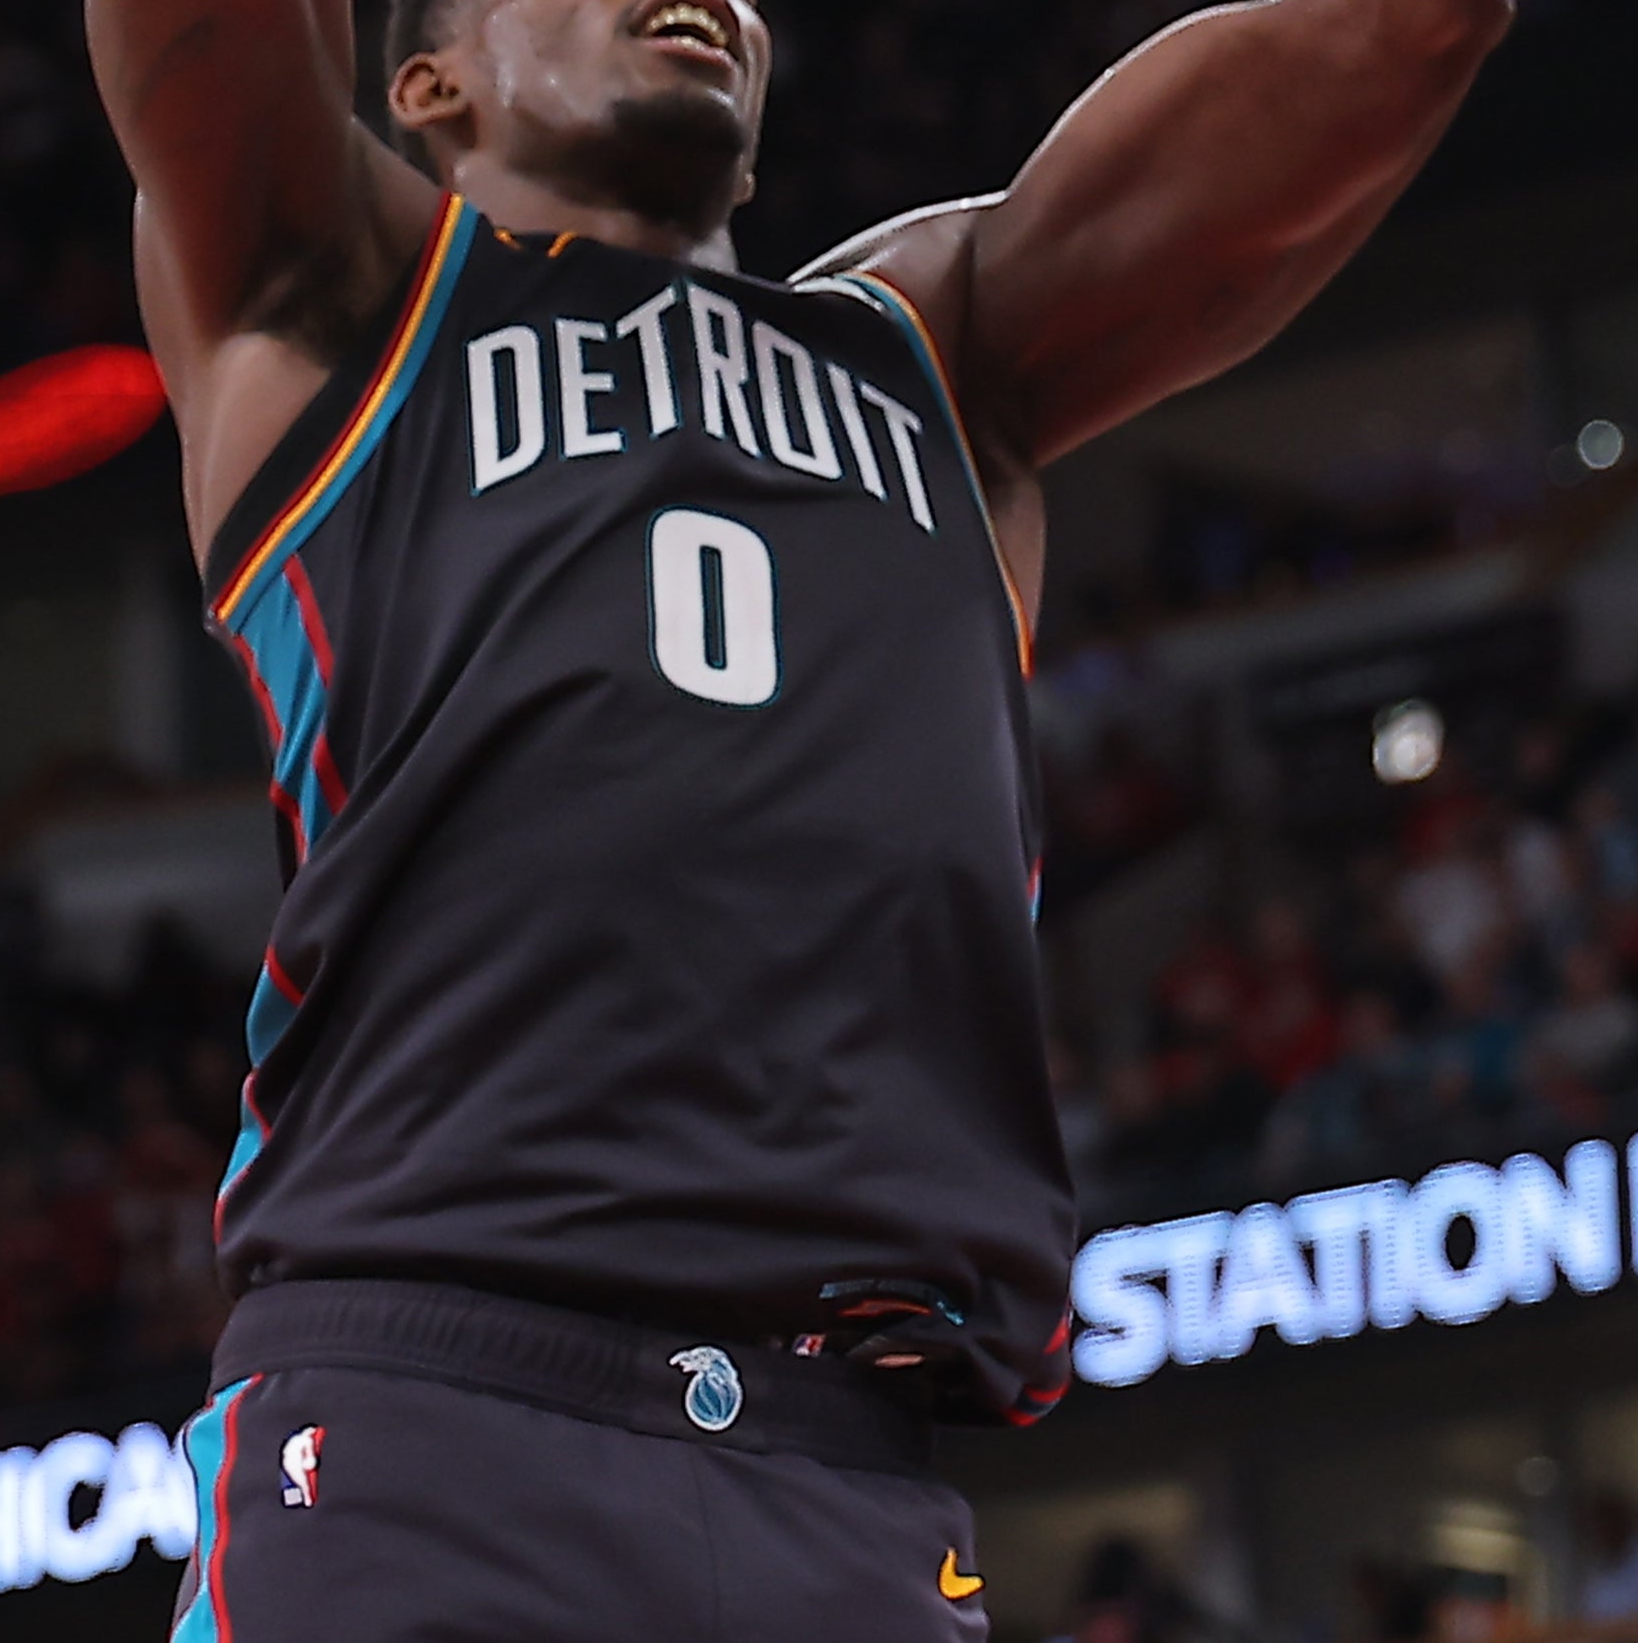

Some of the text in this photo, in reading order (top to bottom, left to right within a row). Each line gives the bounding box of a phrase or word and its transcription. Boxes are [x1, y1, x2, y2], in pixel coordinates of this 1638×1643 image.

[465, 278, 938, 536] DETROIT
[646, 504, 782, 710] 0
[1070, 1138, 1624, 1388] STATION
